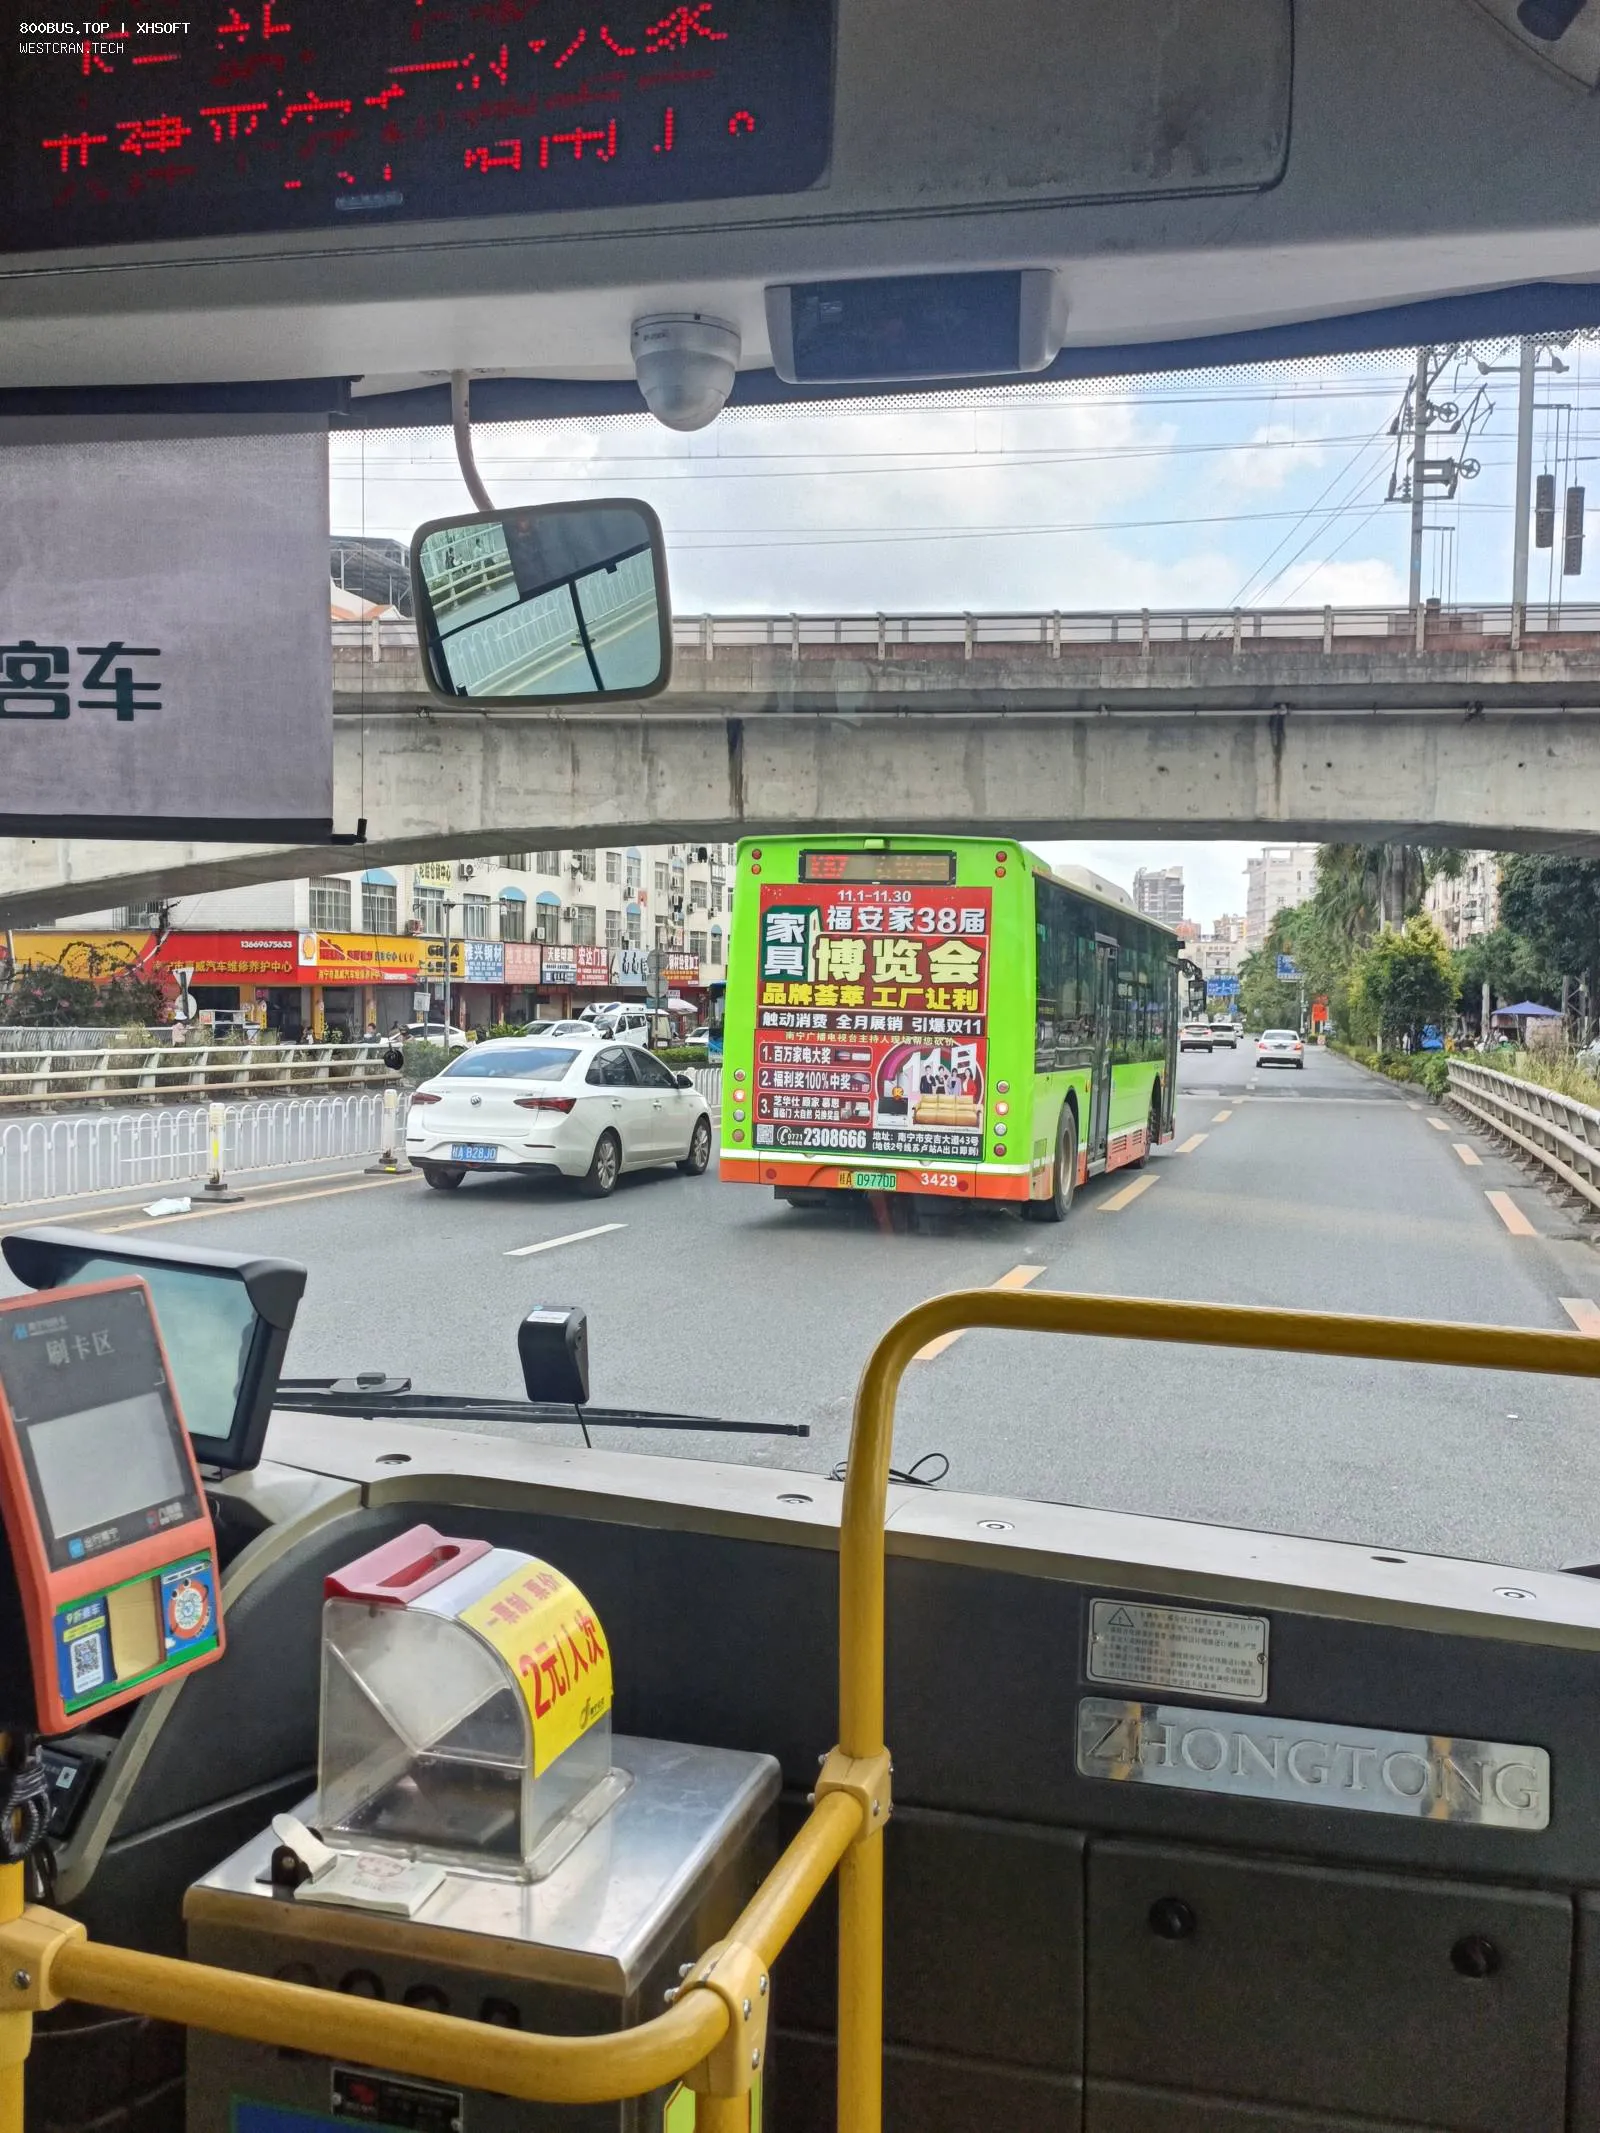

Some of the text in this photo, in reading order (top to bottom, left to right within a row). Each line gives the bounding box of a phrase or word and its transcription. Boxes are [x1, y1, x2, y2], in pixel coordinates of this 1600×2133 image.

[0, 640, 162, 721] 客车
[837, 889, 912, 903] 11.1-11.30
[827, 905, 986, 934] 福安家38届
[764, 912, 806, 977] 家具
[815, 937, 982, 984] 博览会
[871, 986, 979, 1011] 工厂让利
[836, 1013, 903, 1031] 全月展销
[912, 1016, 982, 1034] 引爆双11
[803, 1127, 867, 1149] 2308666
[920, 1173, 958, 1187] 3429
[46, 1329, 116, 1367] 刷卡区
[518, 1609, 605, 1720] 2元/人次
[1085, 1712, 1540, 1812] ZHONGTONG
